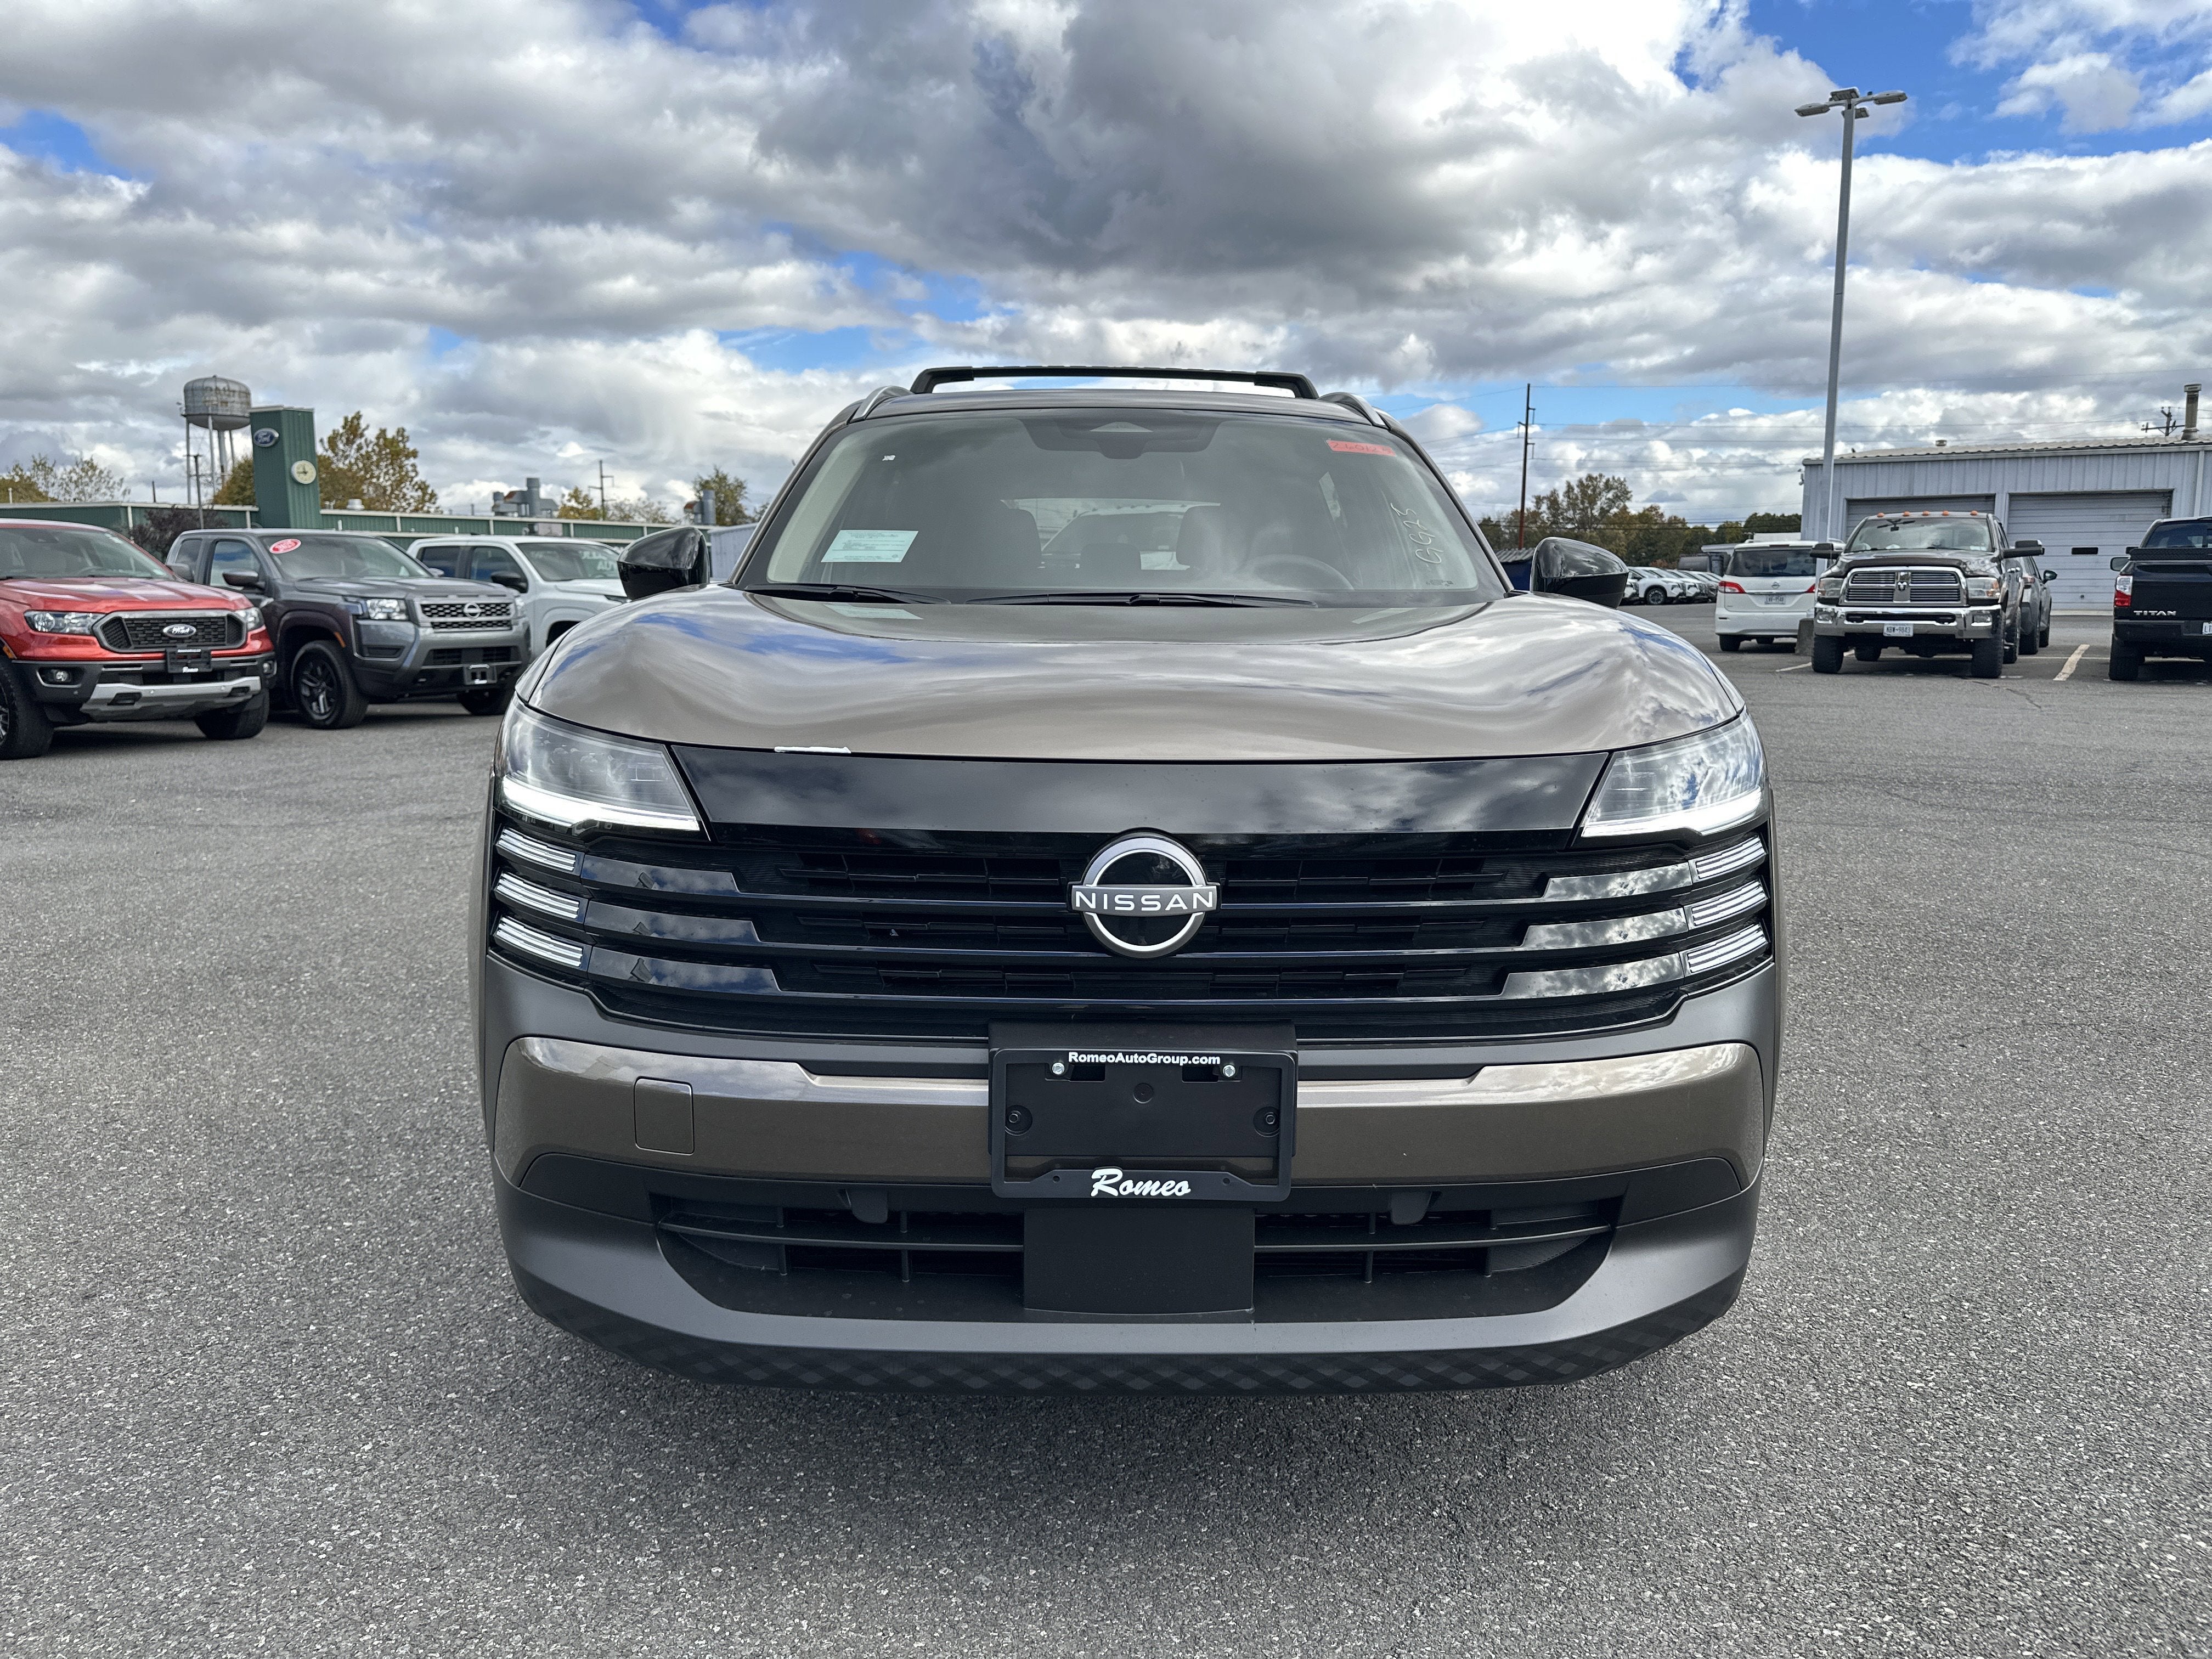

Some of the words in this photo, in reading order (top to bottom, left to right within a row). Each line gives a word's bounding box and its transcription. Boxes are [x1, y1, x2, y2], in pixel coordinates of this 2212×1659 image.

[1075, 891, 1213, 911] NISSAN
[1068, 1052, 1221, 1066] RomeoAutoGroup.com
[1091, 1168, 1191, 1197] Romeo
